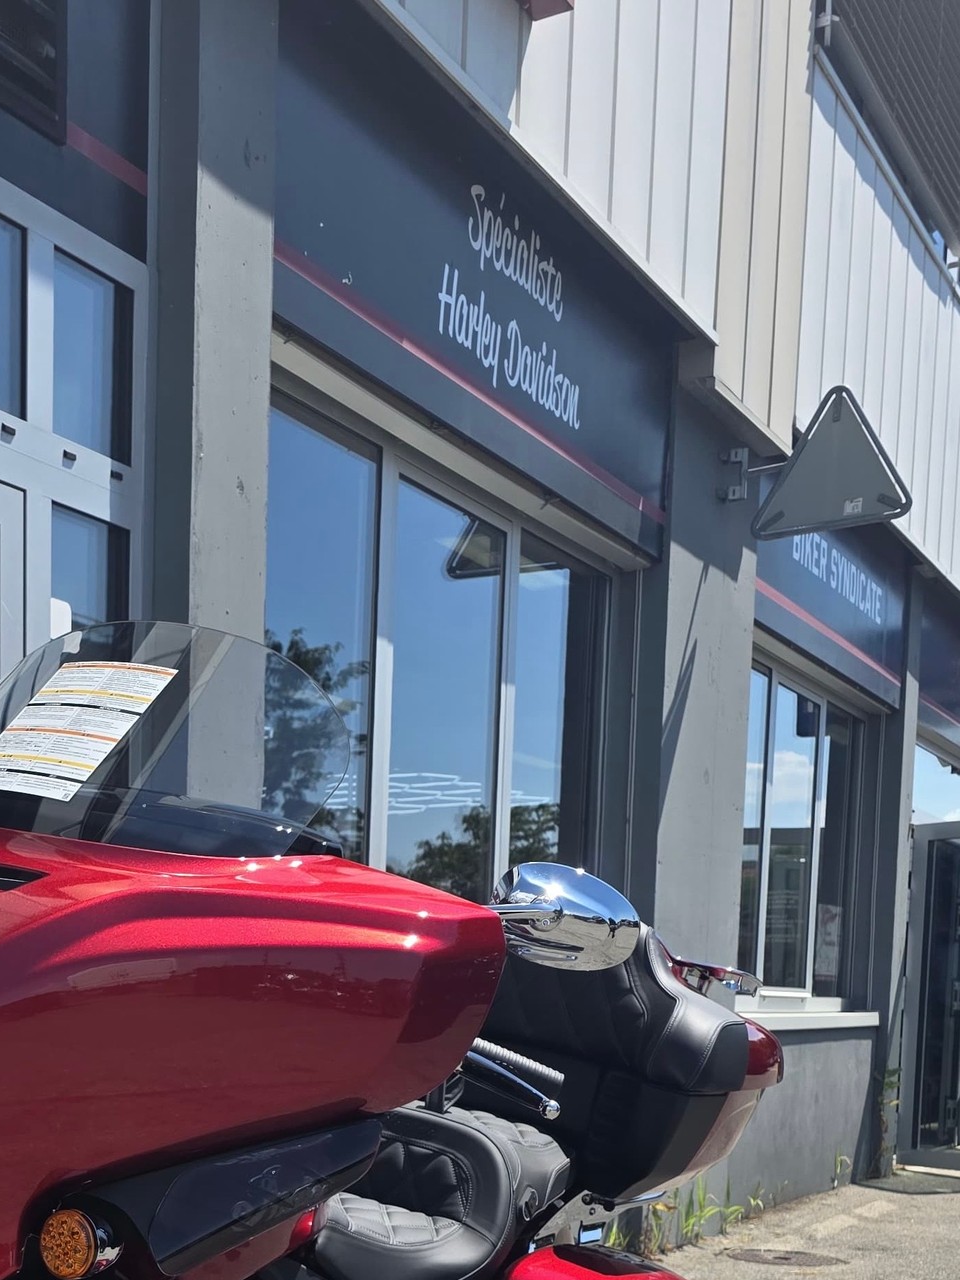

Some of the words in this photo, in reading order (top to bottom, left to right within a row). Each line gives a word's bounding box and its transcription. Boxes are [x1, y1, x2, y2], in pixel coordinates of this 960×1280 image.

[468, 184, 563, 322] Spécialiste
[438, 263, 501, 388] Harley
[504, 319, 580, 430] Davidson
[792, 532, 828, 582] BIKER
[830, 548, 883, 625] SYNDICATE
